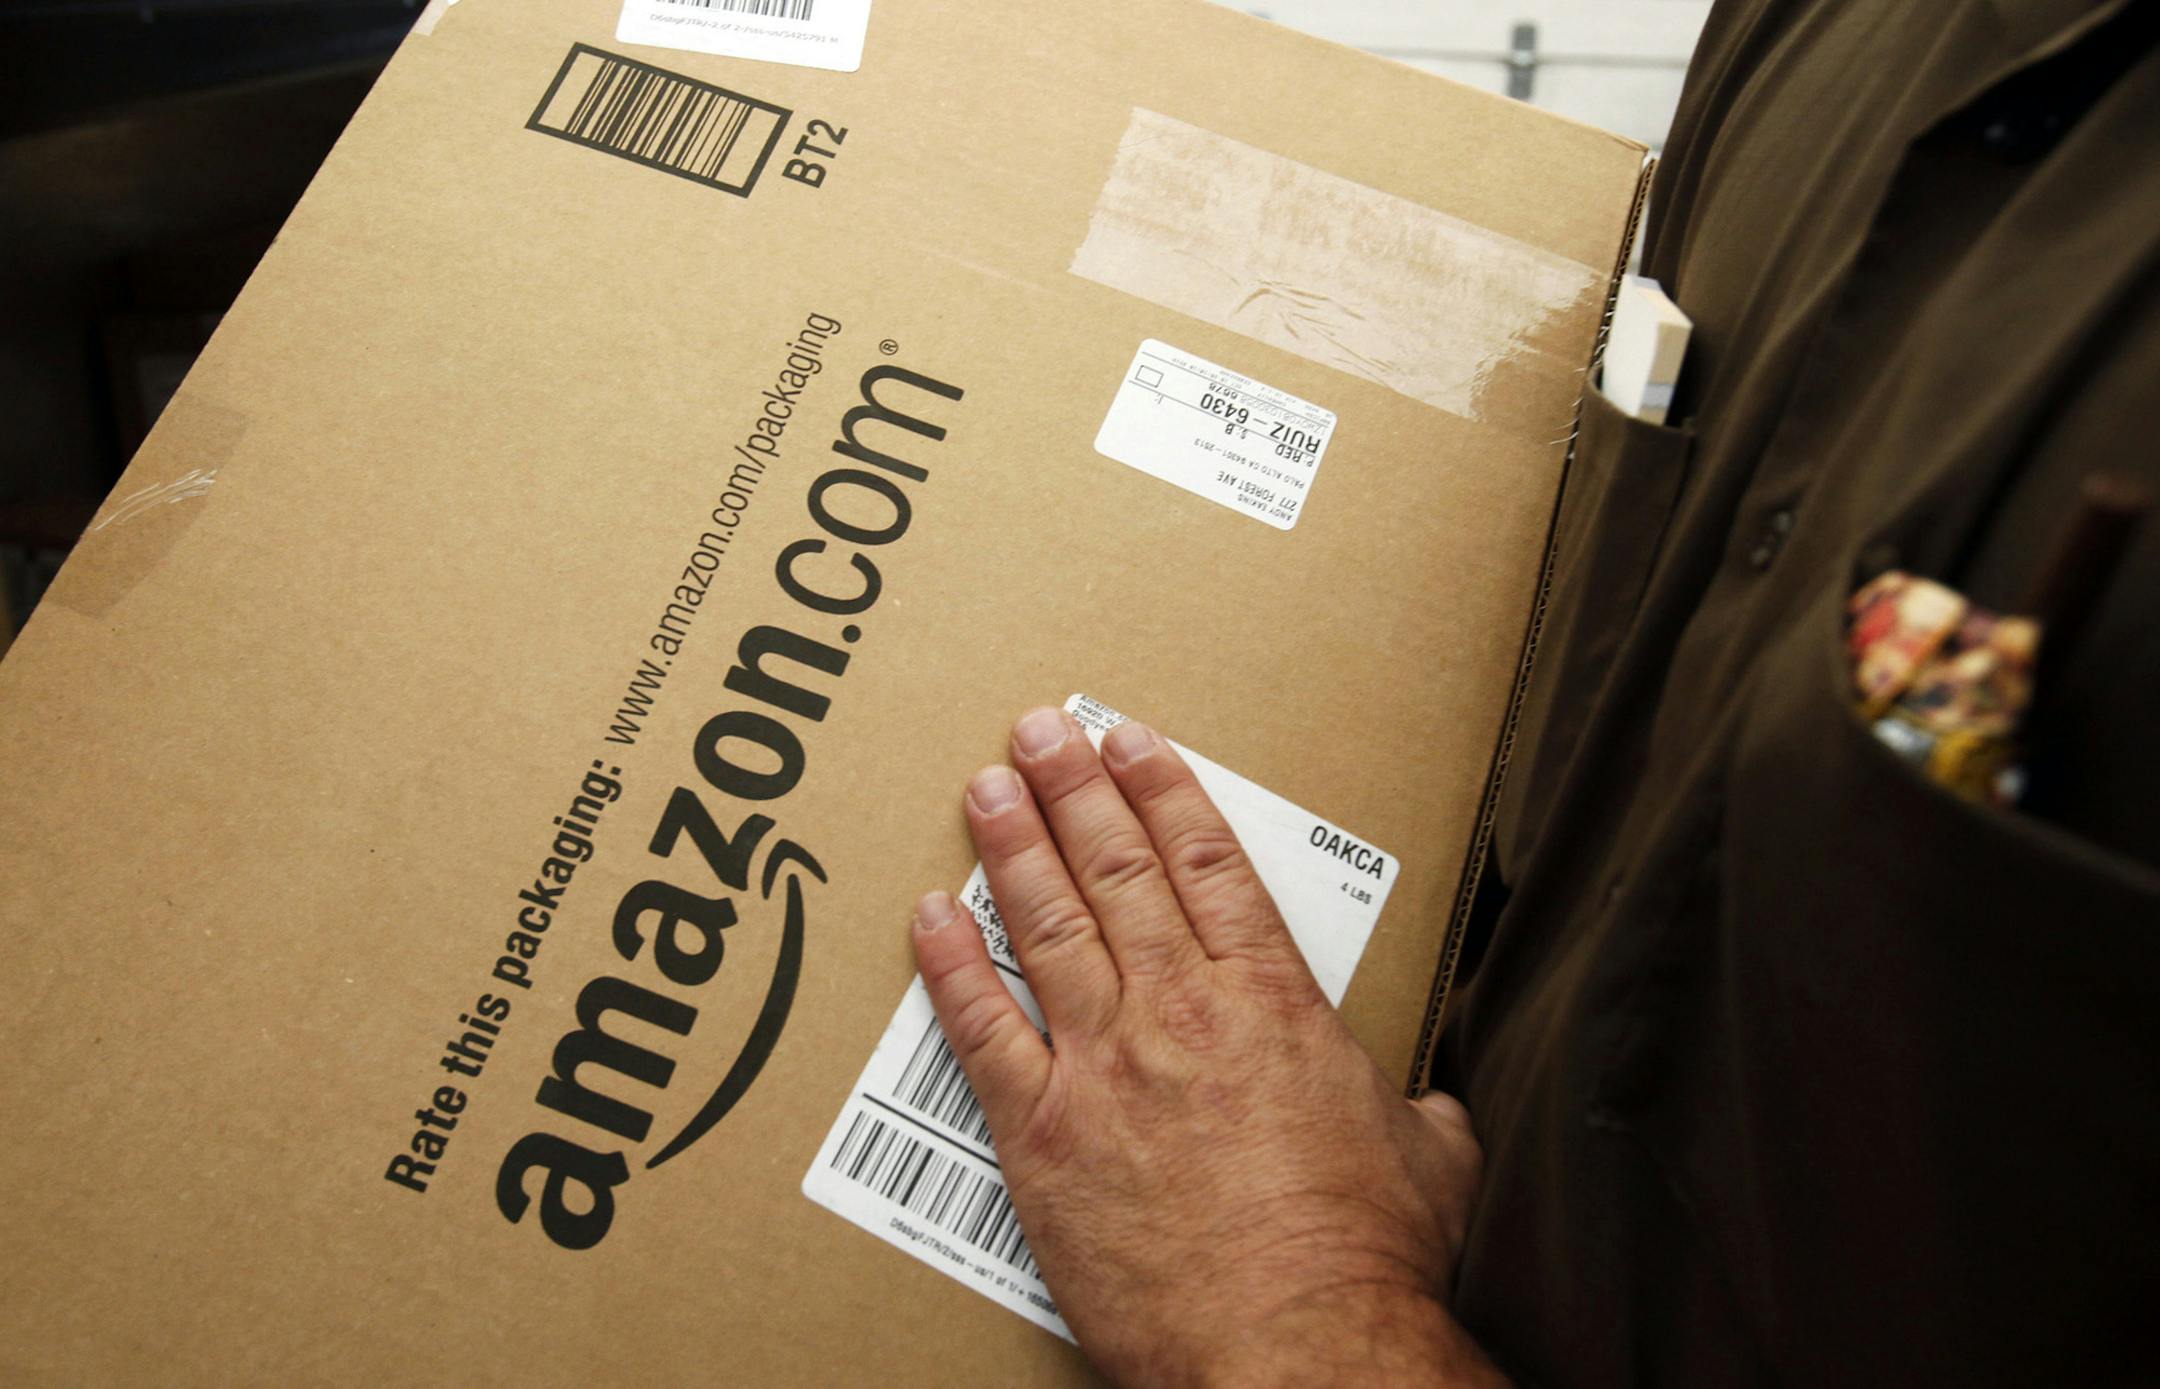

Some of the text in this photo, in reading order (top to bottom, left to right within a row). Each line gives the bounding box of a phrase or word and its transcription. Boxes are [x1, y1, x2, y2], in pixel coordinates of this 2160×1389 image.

[781, 119, 848, 188] BT2
[1199, 392, 1250, 425] 6430
[1225, 423, 1236, 435] B
[1275, 443, 1303, 464] RED
[1260, 463, 1284, 482] ALTO
[1284, 473, 1304, 489] PALO
[1216, 470, 1297, 512] 277 FOREST AVE
[384, 311, 841, 1193] Rate this packaging: www.amazon.com/packaging
[1310, 825, 1384, 880] OAKCA
[1340, 882, 1372, 905] 4 LBS
